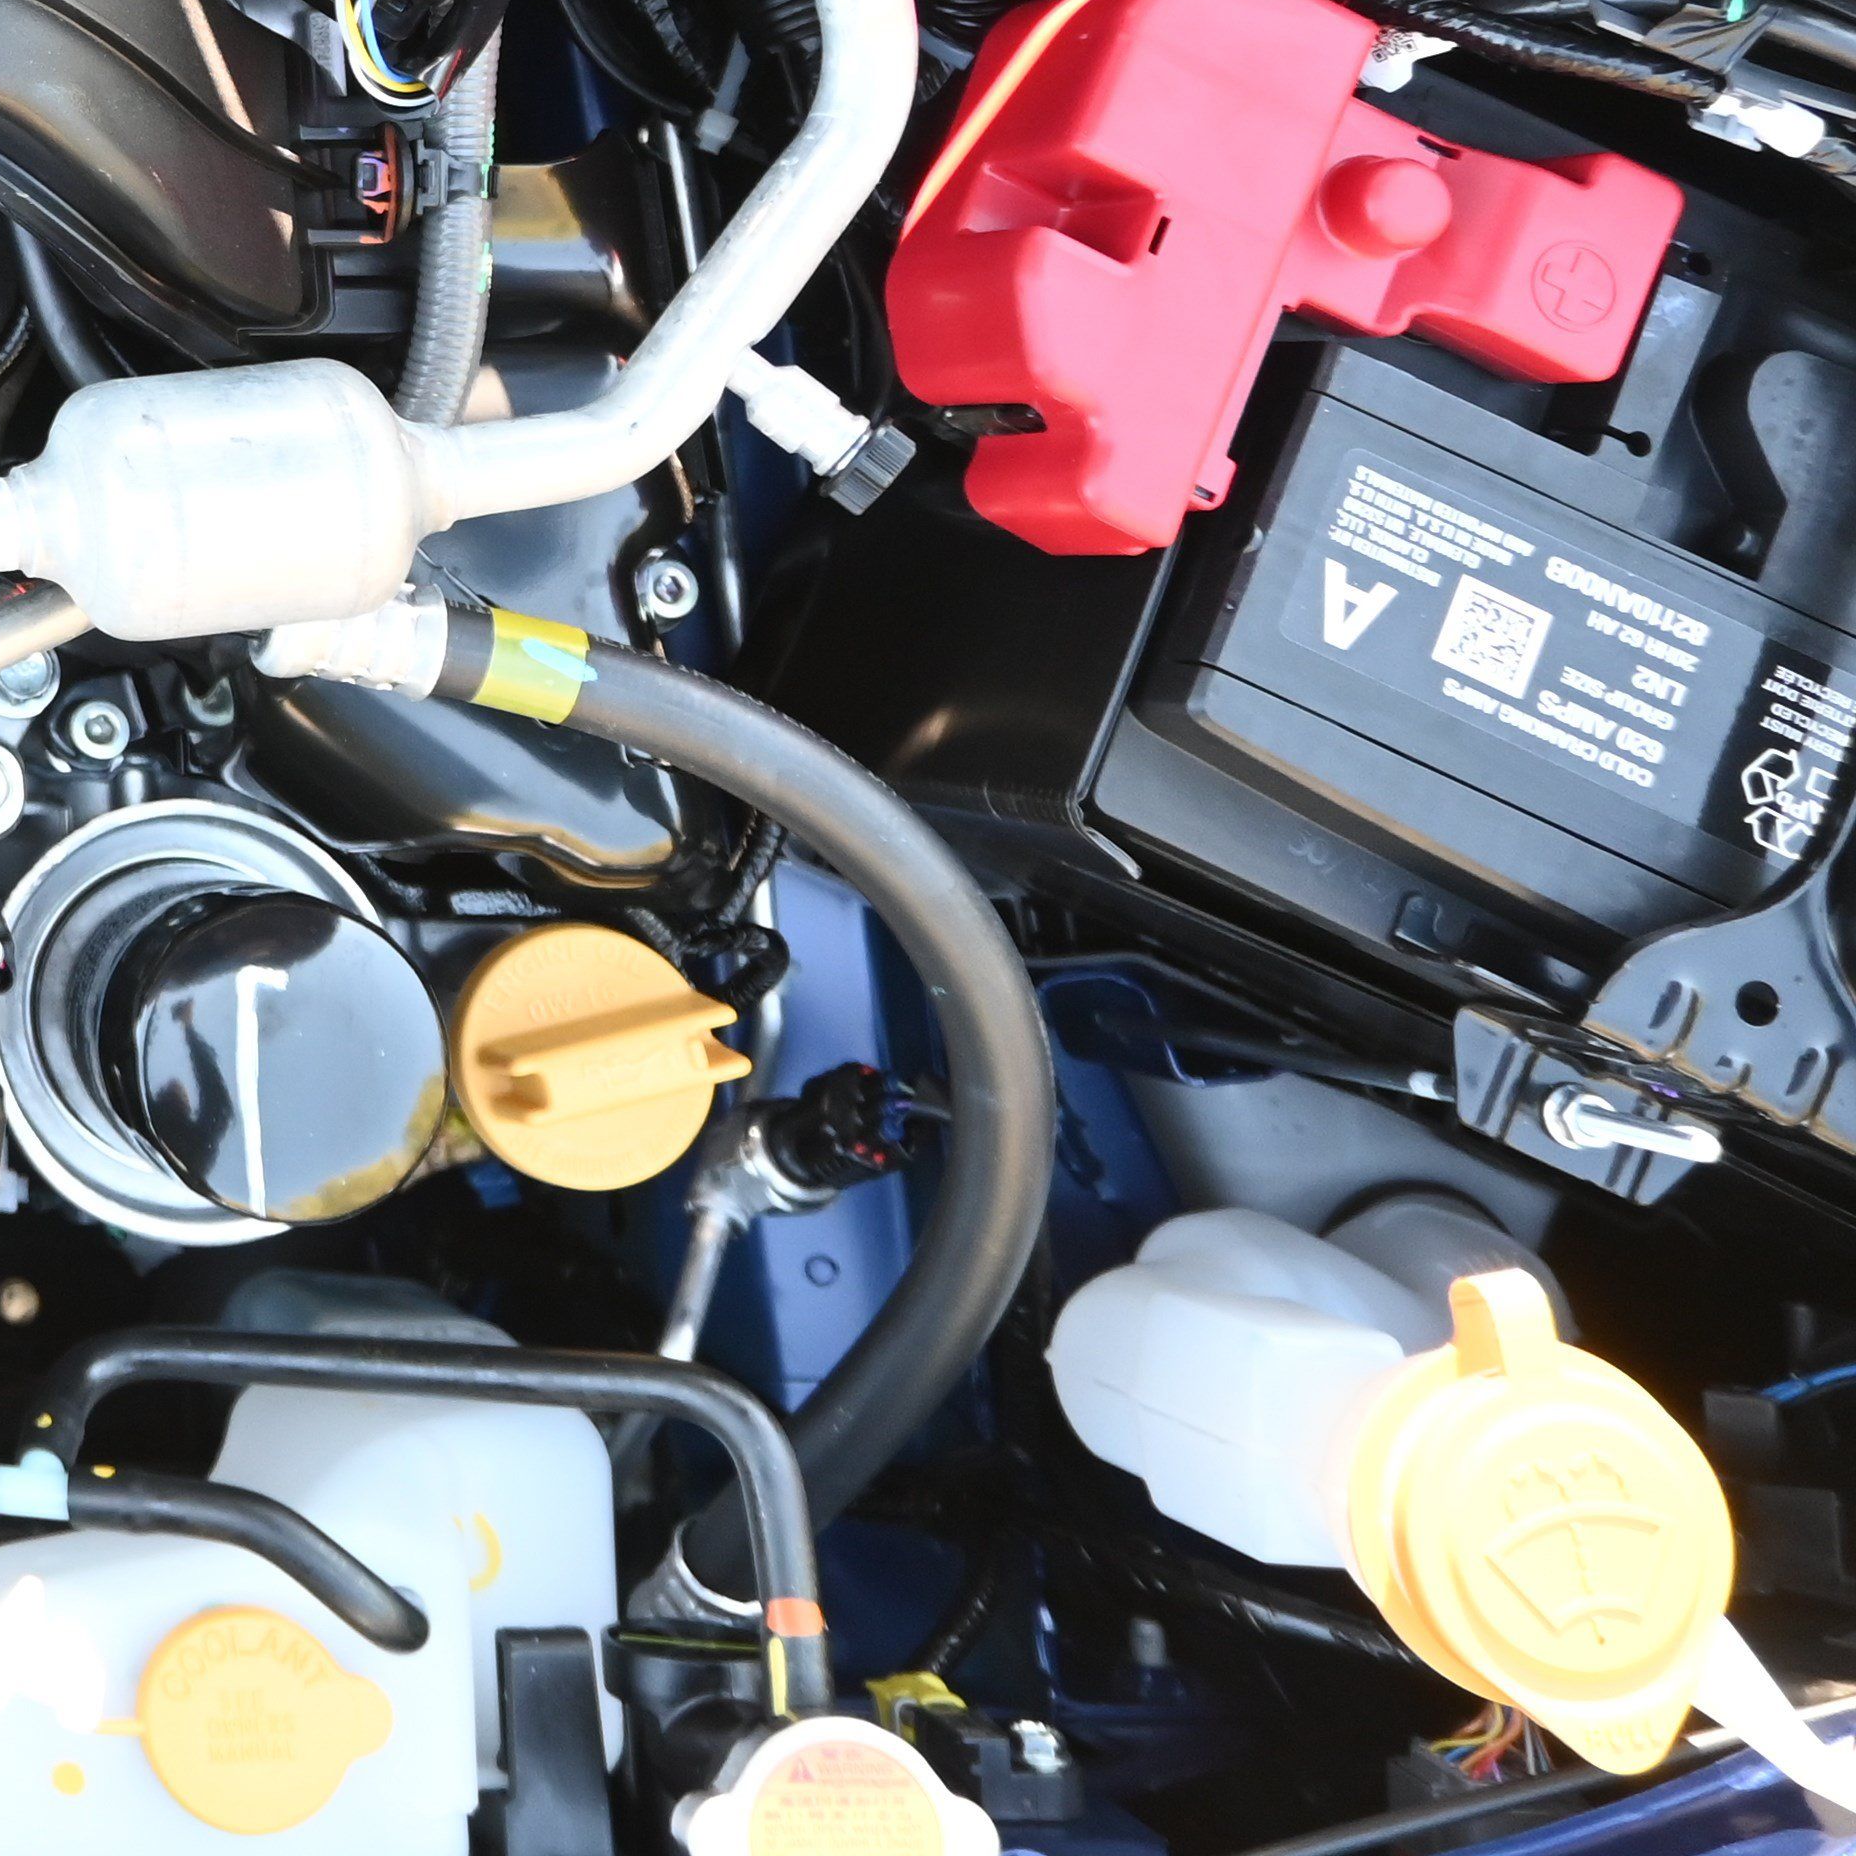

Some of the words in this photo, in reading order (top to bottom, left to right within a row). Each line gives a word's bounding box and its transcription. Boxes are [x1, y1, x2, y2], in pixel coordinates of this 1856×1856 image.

[1354, 465, 1433, 512] MATERIALS
[1374, 493, 1412, 519] WITH
[1432, 501, 1503, 544] IMPORTED
[1454, 530, 1471, 546] IN
[1352, 536, 1441, 587] DISTRIBUTED
[1470, 537, 1513, 565] MADE
[1503, 534, 1533, 556] AND
[1323, 557, 1399, 651] A
[1588, 612, 1617, 634] AH
[1620, 626, 1644, 646] 62
[1443, 679, 1497, 714] AMPS
[1561, 668, 1605, 698] SIZE
[1631, 666, 1685, 704] LN2
[1763, 678, 1798, 701] DOIT
[1536, 690, 1615, 742] AMPS
[1606, 688, 1674, 730] GROUP
[1499, 705, 1597, 761] CRANKING
[1616, 728, 1665, 763] 620
[1761, 716, 1802, 742] MUST
[1600, 753, 1652, 786] COLD
[484, 944, 586, 1014] ENGINE
[161, 1625, 332, 1701] COOLANT
[818, 1761, 895, 1776] WARNING
